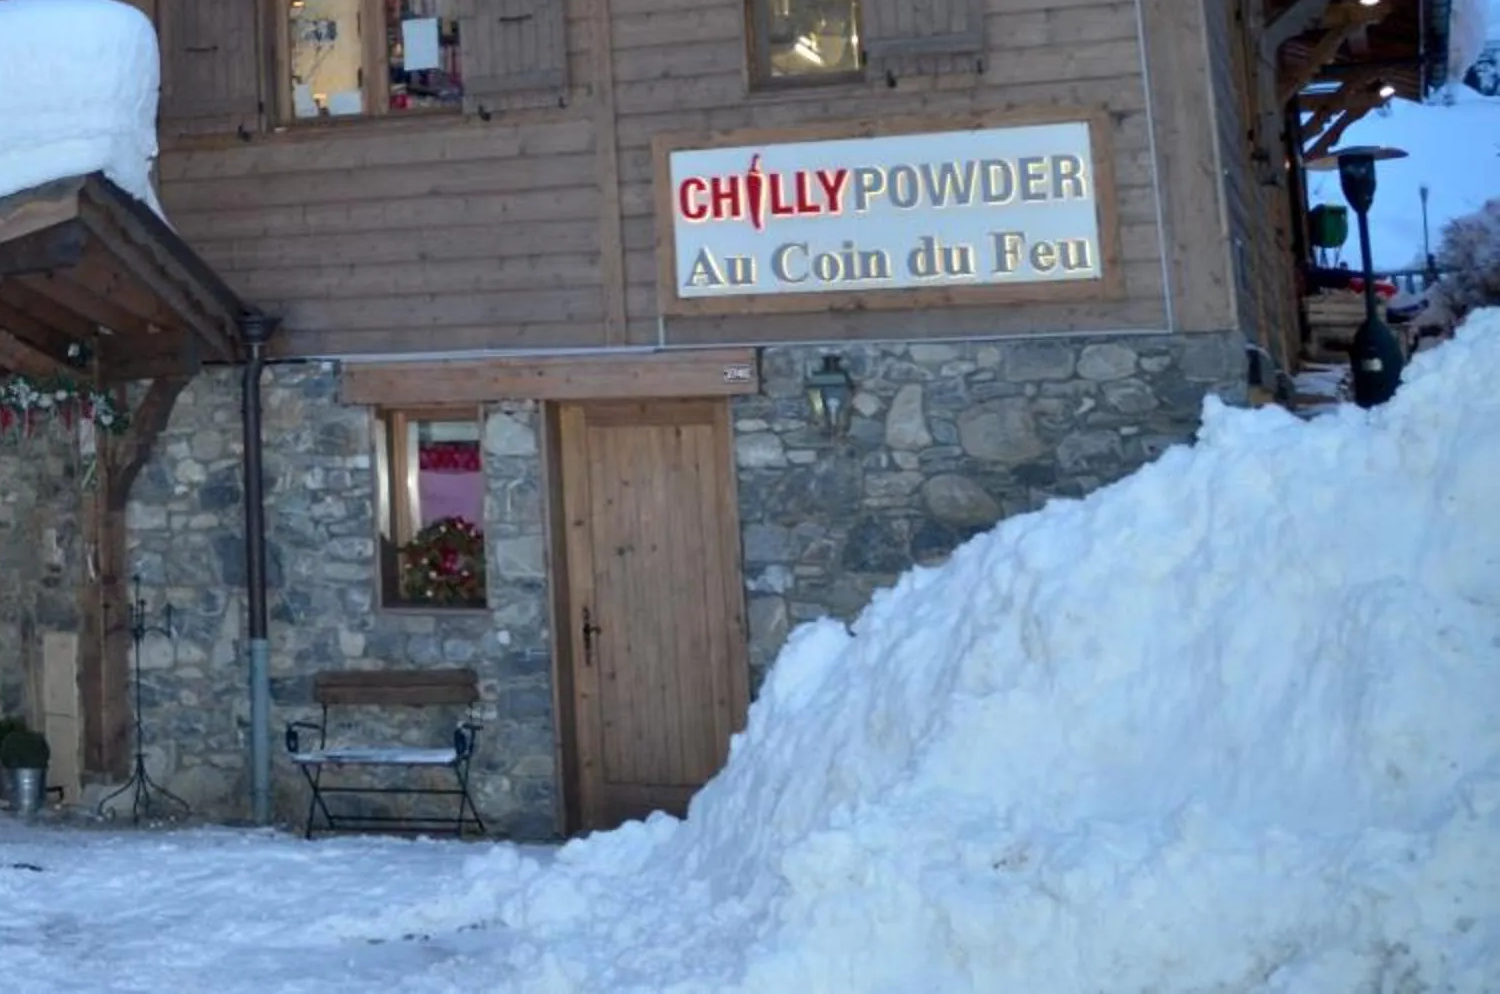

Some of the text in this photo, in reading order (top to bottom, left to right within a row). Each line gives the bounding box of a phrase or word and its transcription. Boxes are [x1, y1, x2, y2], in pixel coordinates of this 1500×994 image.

[685, 231, 1092, 287] Au Coin du Feu
